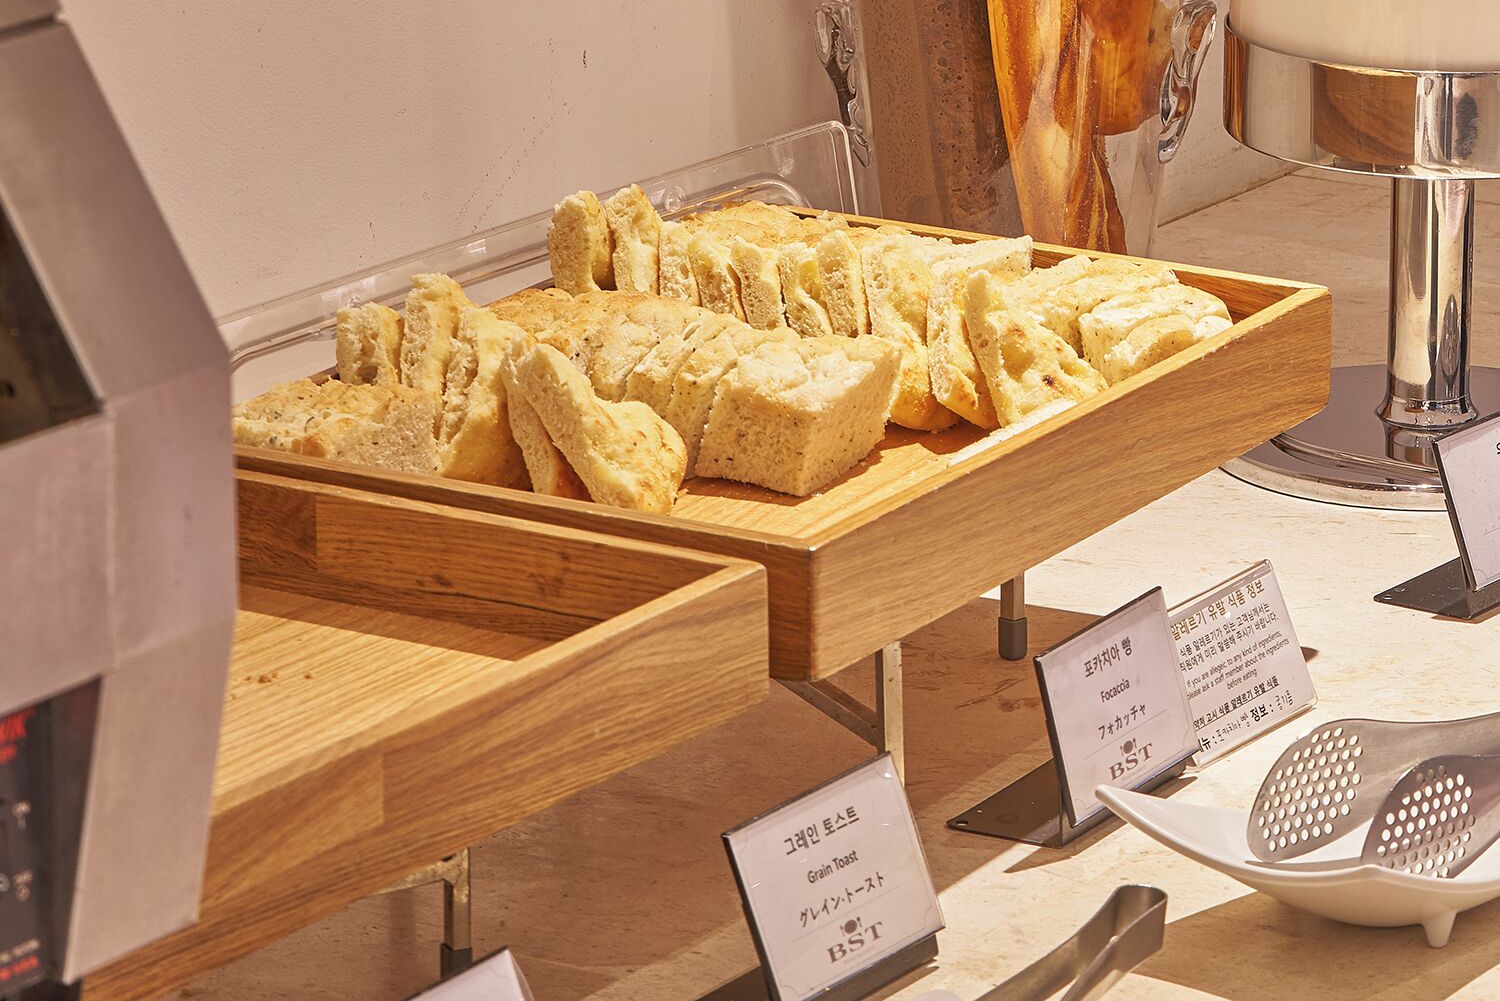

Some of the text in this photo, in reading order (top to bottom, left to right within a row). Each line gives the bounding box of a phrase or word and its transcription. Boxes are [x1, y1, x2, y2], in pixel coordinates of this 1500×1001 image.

[1171, 579, 1265, 641] 알레르기 유발 식품 정보
[1179, 644, 1192, 657] 식품
[1223, 621, 1236, 635] 있는
[1236, 626, 1255, 640] 주시기
[1084, 636, 1132, 678] 포카치아 빵
[1191, 677, 1201, 687] you
[1241, 646, 1253, 657] kind
[1225, 663, 1244, 679] member
[1244, 656, 1259, 669] about
[1100, 679, 1131, 703] Focaccia
[1218, 702, 1230, 715] 식품
[1230, 689, 1254, 709] 알레르기
[1253, 682, 1266, 696] 유발
[1266, 675, 1280, 689] 식품
[1226, 668, 1258, 691] before eating
[1098, 704, 1146, 740] フォカッチャ
[1250, 704, 1269, 722] 정보
[1109, 743, 1152, 780] BST
[783, 806, 860, 856] 그레인 토스트
[807, 850, 859, 884] Grain Toast
[827, 921, 883, 963] BST
